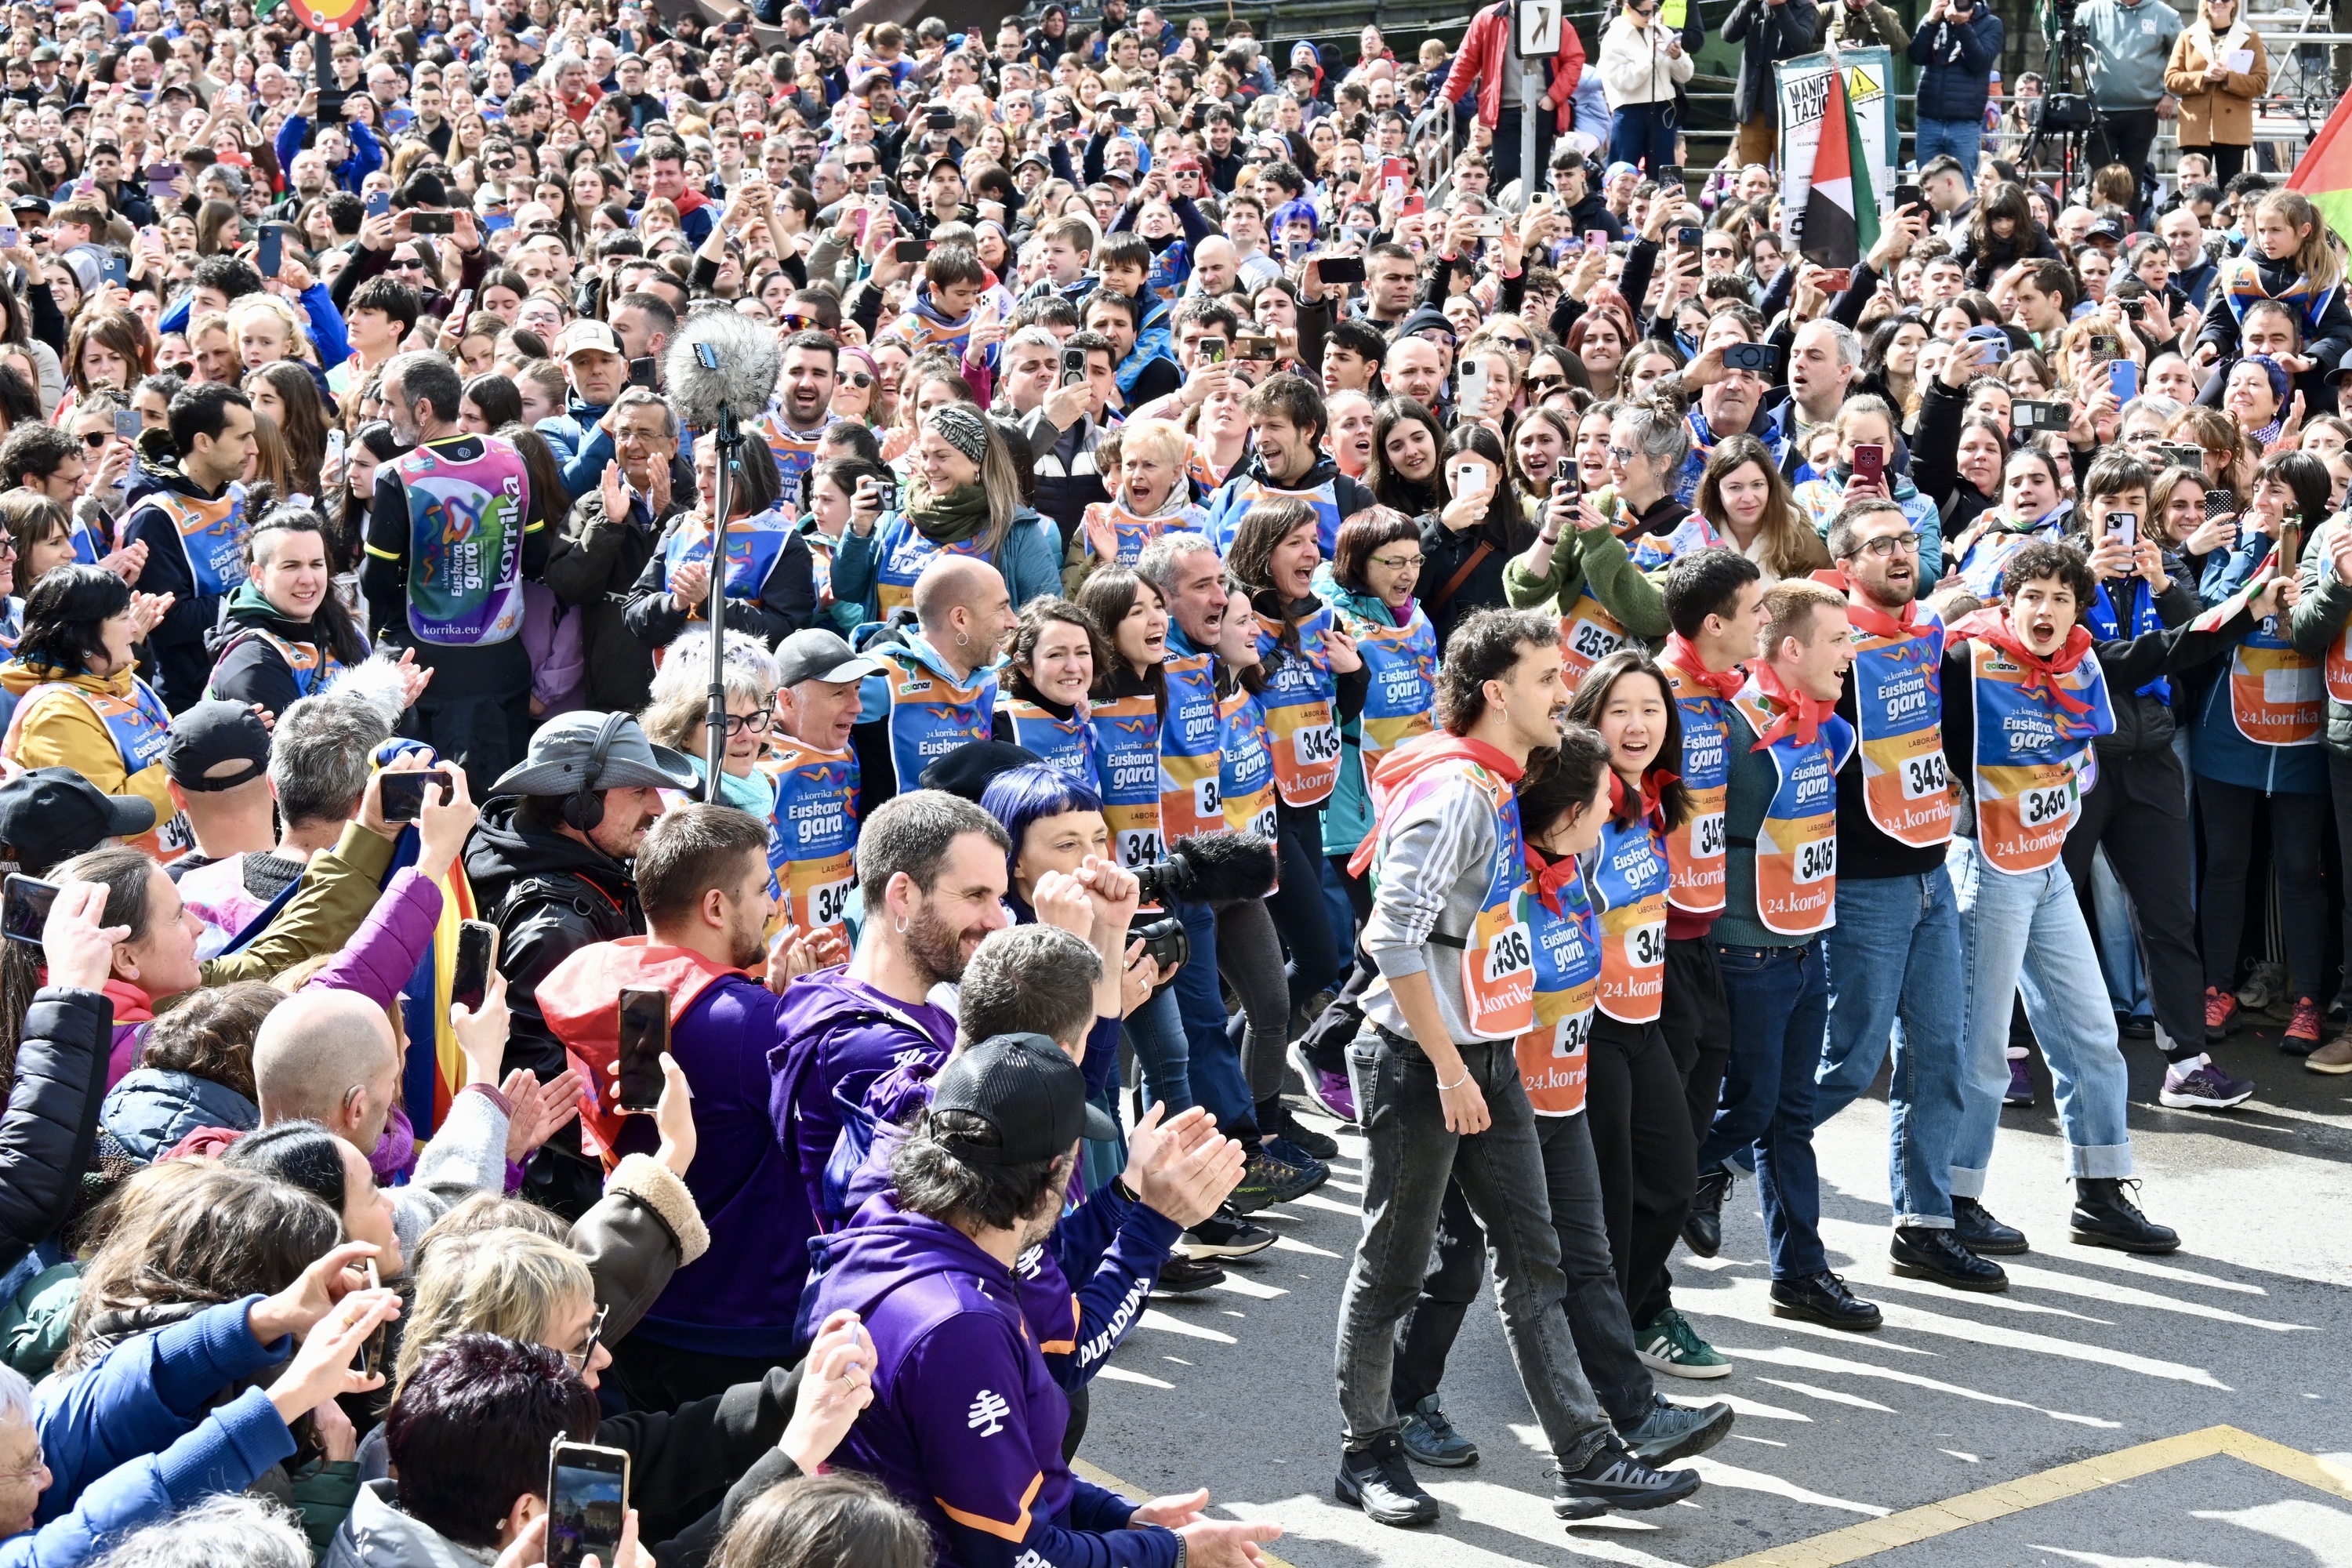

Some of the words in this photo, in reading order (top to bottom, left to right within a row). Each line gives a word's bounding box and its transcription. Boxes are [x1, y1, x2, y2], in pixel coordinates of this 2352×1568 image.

[695, 344, 708, 367] radius
[493, 474, 521, 592] korrika
[450, 544, 463, 597] Euskara
[464, 542, 483, 590] gara
[423, 624, 481, 635] korrika.eus
[496, 612, 517, 630] aek
[1277, 670, 1316, 692] gara
[1883, 667, 1913, 683] 24.korrika
[2328, 667, 2352, 685] 24.ko
[1878, 677, 1925, 700] Euskara
[1886, 691, 1926, 722] gara
[2241, 709, 2318, 726] 24.korrika
[926, 728, 958, 739] 24.korrika
[1114, 741, 1142, 752] 24.korrika
[1106, 752, 1154, 768] Euskara
[1234, 751, 1266, 782] gara
[1688, 747, 1722, 774] gara
[1112, 765, 1156, 790] gara
[1910, 755, 1945, 794] 343
[797, 789, 833, 802] 24.korrika
[1795, 775, 1829, 804] gara
[788, 800, 843, 820] Euskara
[797, 814, 843, 844] gara
[1995, 826, 2064, 857] 24.korrika
[1127, 833, 1160, 866] 34
[1802, 839, 1834, 880] 3436
[1539, 926, 1579, 950] Euskara
[1553, 940, 1585, 973] gara
[1477, 982, 1533, 1016] 4.korrika
[1076, 1278, 1150, 1368] DURADUNA
